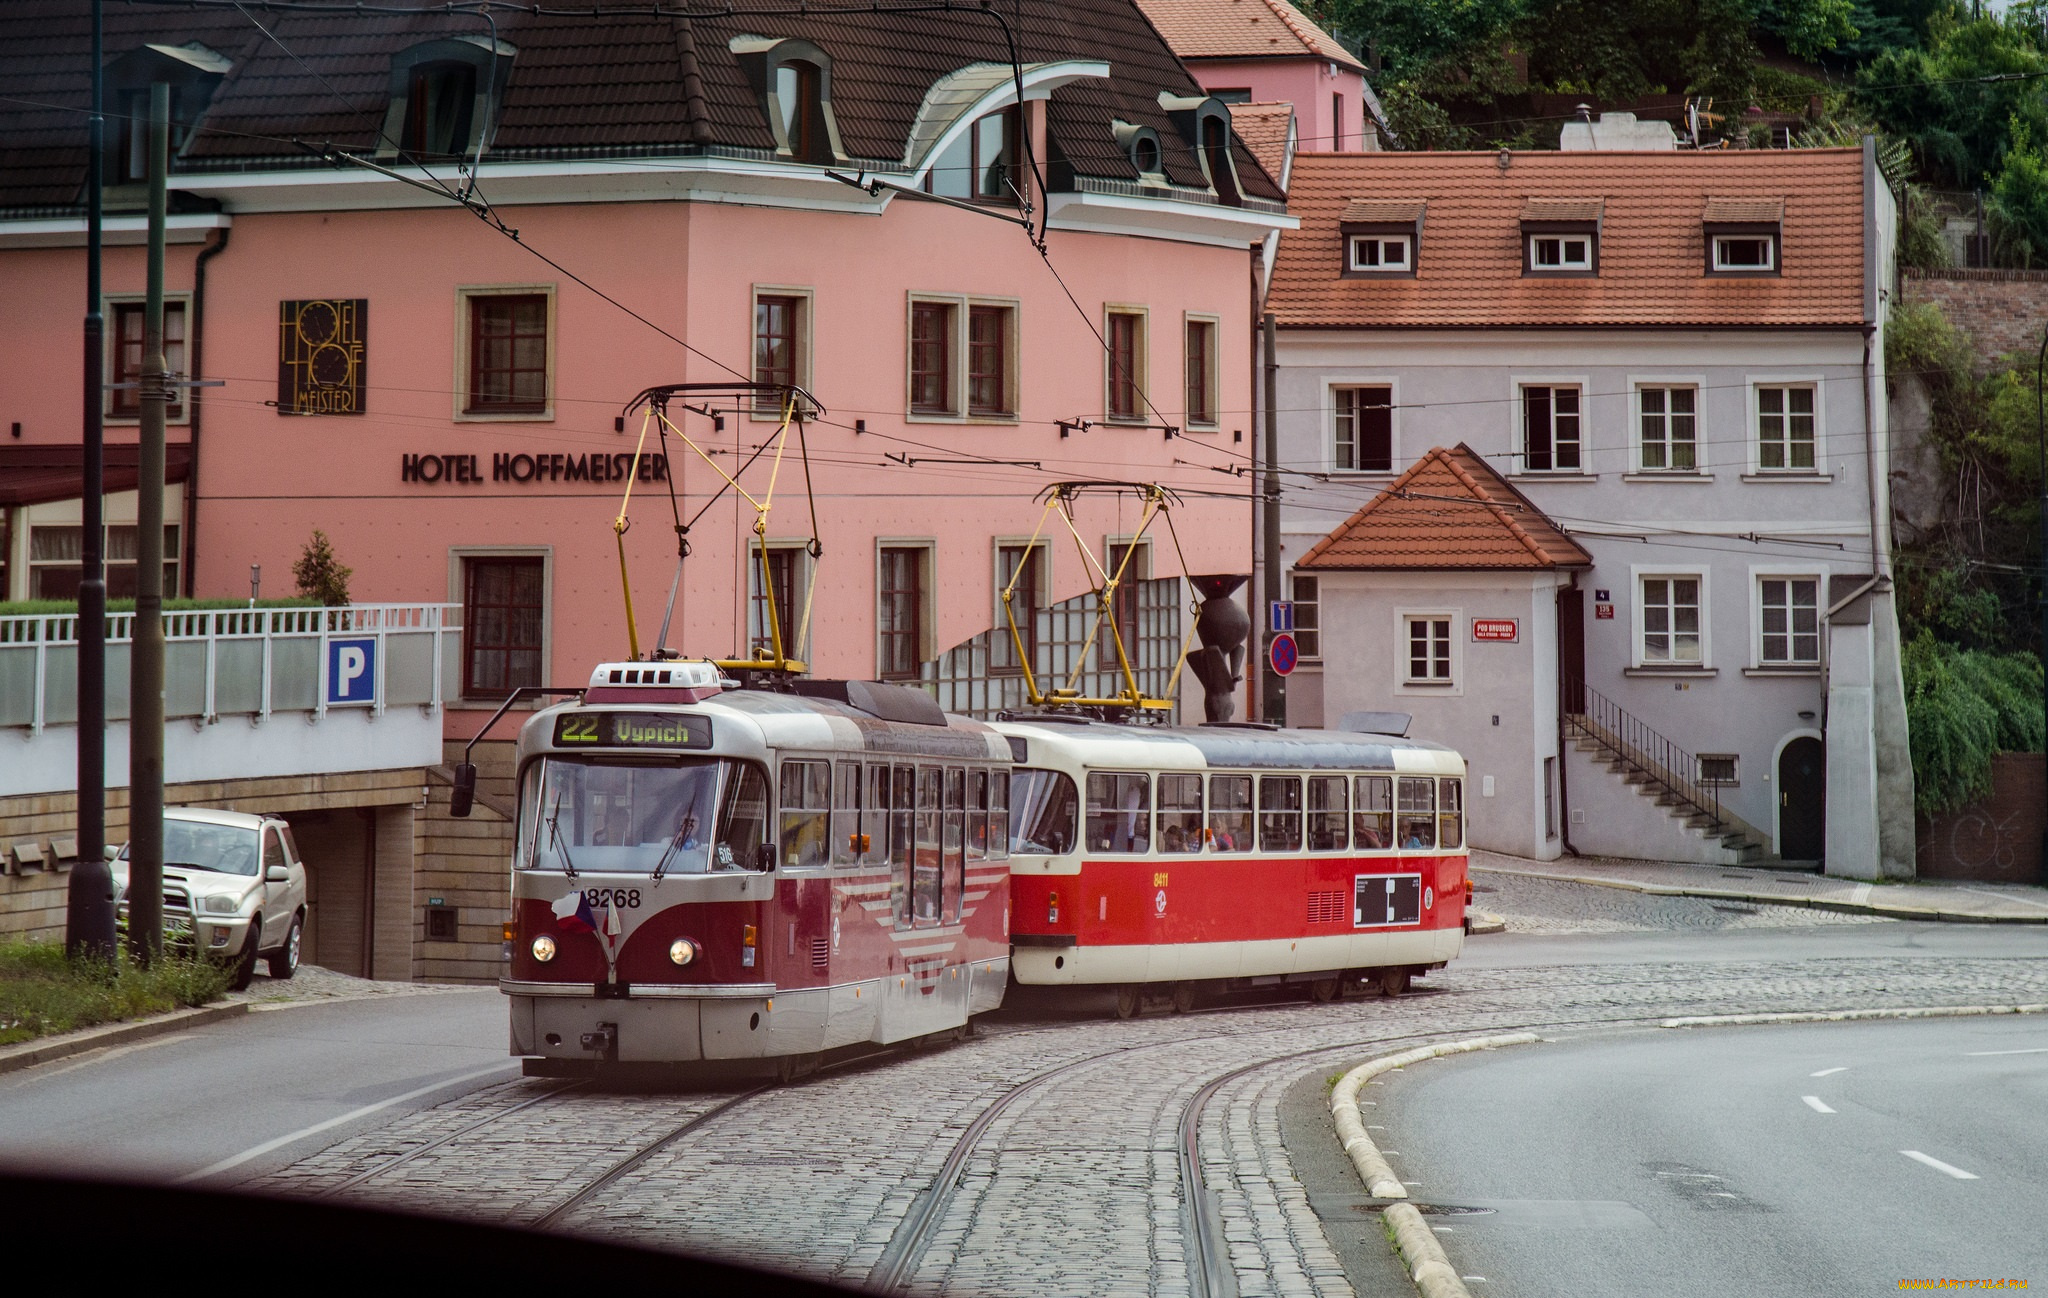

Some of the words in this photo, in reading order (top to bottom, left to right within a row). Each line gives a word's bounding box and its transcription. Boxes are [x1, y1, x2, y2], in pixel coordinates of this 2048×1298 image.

[299, 391, 352, 413] MEISTER
[402, 453, 483, 482] HOTEL
[493, 452, 668, 481] HOFFMEISTER
[1600, 591, 1605, 599] 4
[1477, 624, 1488, 632] POD
[1489, 624, 1513, 633] BRUSKOU
[338, 646, 366, 697] P
[561, 717, 599, 742] 22
[617, 718, 689, 743] Vypich
[718, 847, 733, 863] 516
[1153, 872, 1169, 887] 8411
[587, 888, 641, 909] 8268
